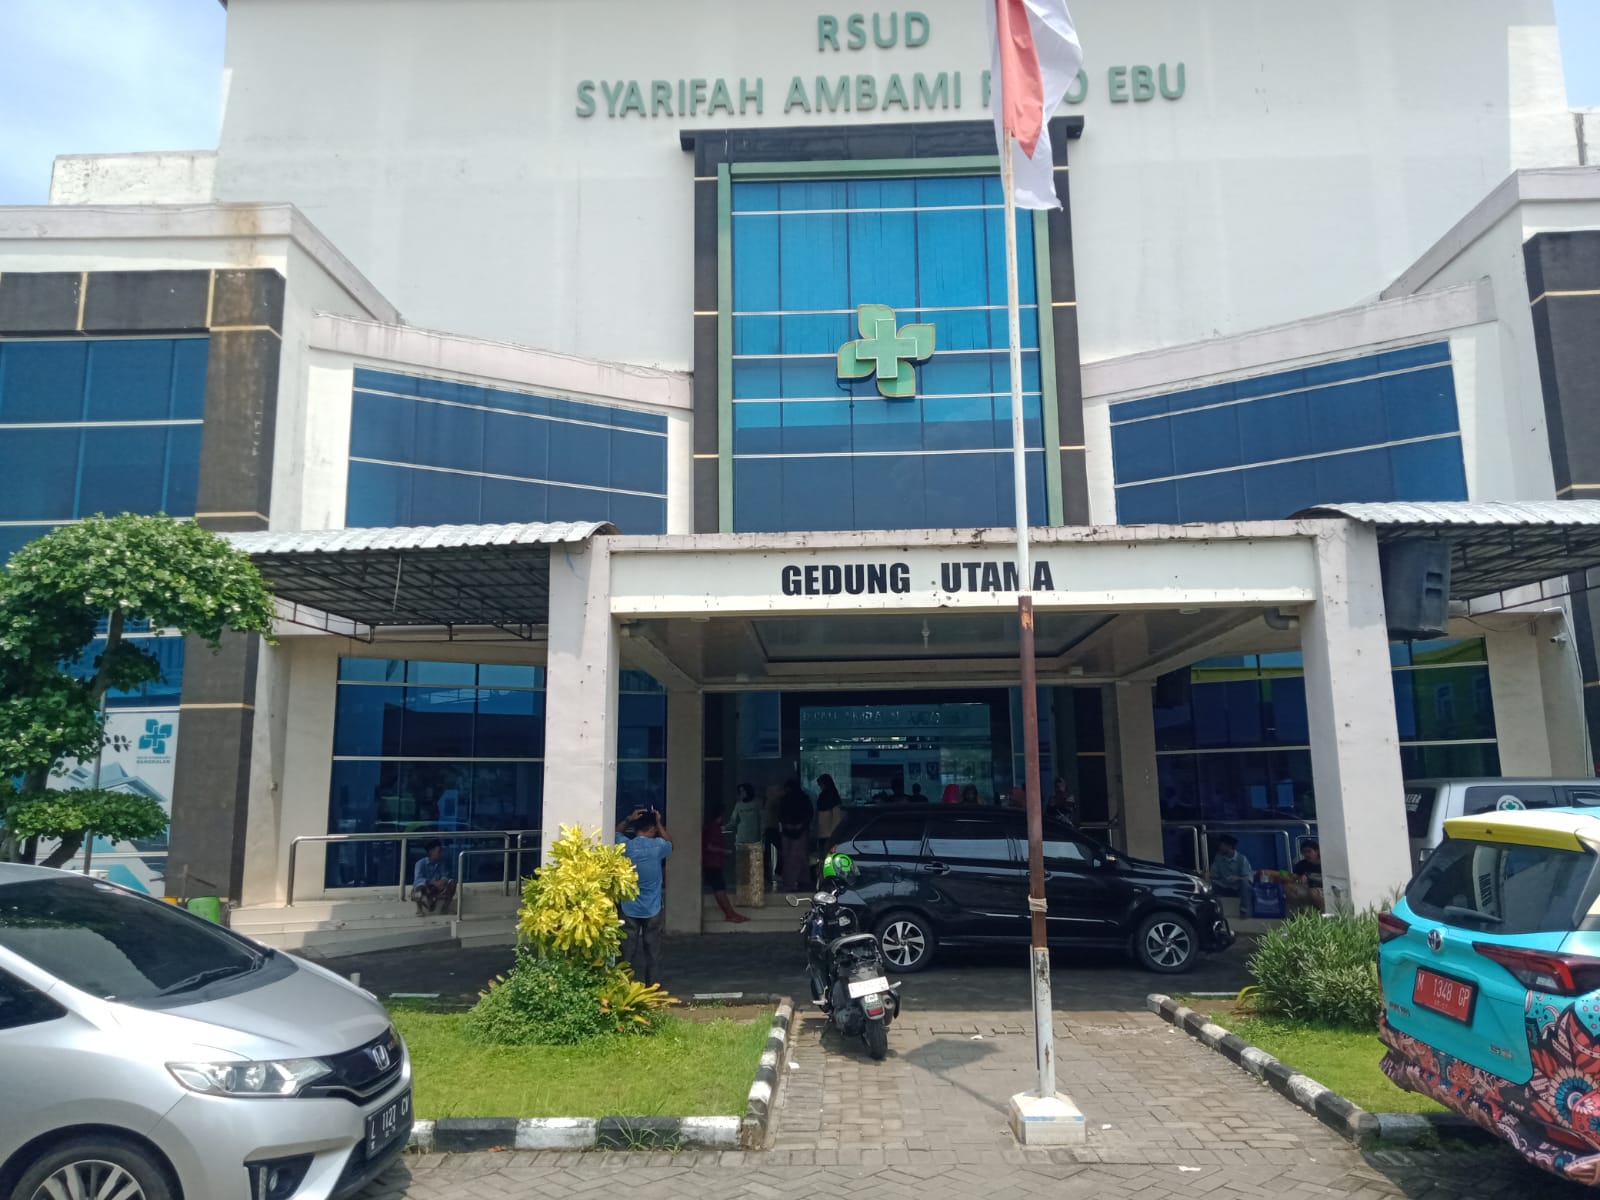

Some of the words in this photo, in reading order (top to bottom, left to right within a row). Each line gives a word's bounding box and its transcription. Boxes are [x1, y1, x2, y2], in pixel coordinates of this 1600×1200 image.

[817, 10, 931, 52] RSUD
[576, 77, 764, 119] SYARIFAH
[784, 69, 962, 115] AMBAMI
[1108, 62, 1187, 104] EBU
[781, 562, 911, 596] GEDUNG
[940, 560, 1055, 594] UTAMA
[1433, 978, 1453, 1002] 1348
[1457, 987, 1470, 1008] GP
[370, 1119, 376, 1140] L
[382, 1104, 397, 1131] 1127
